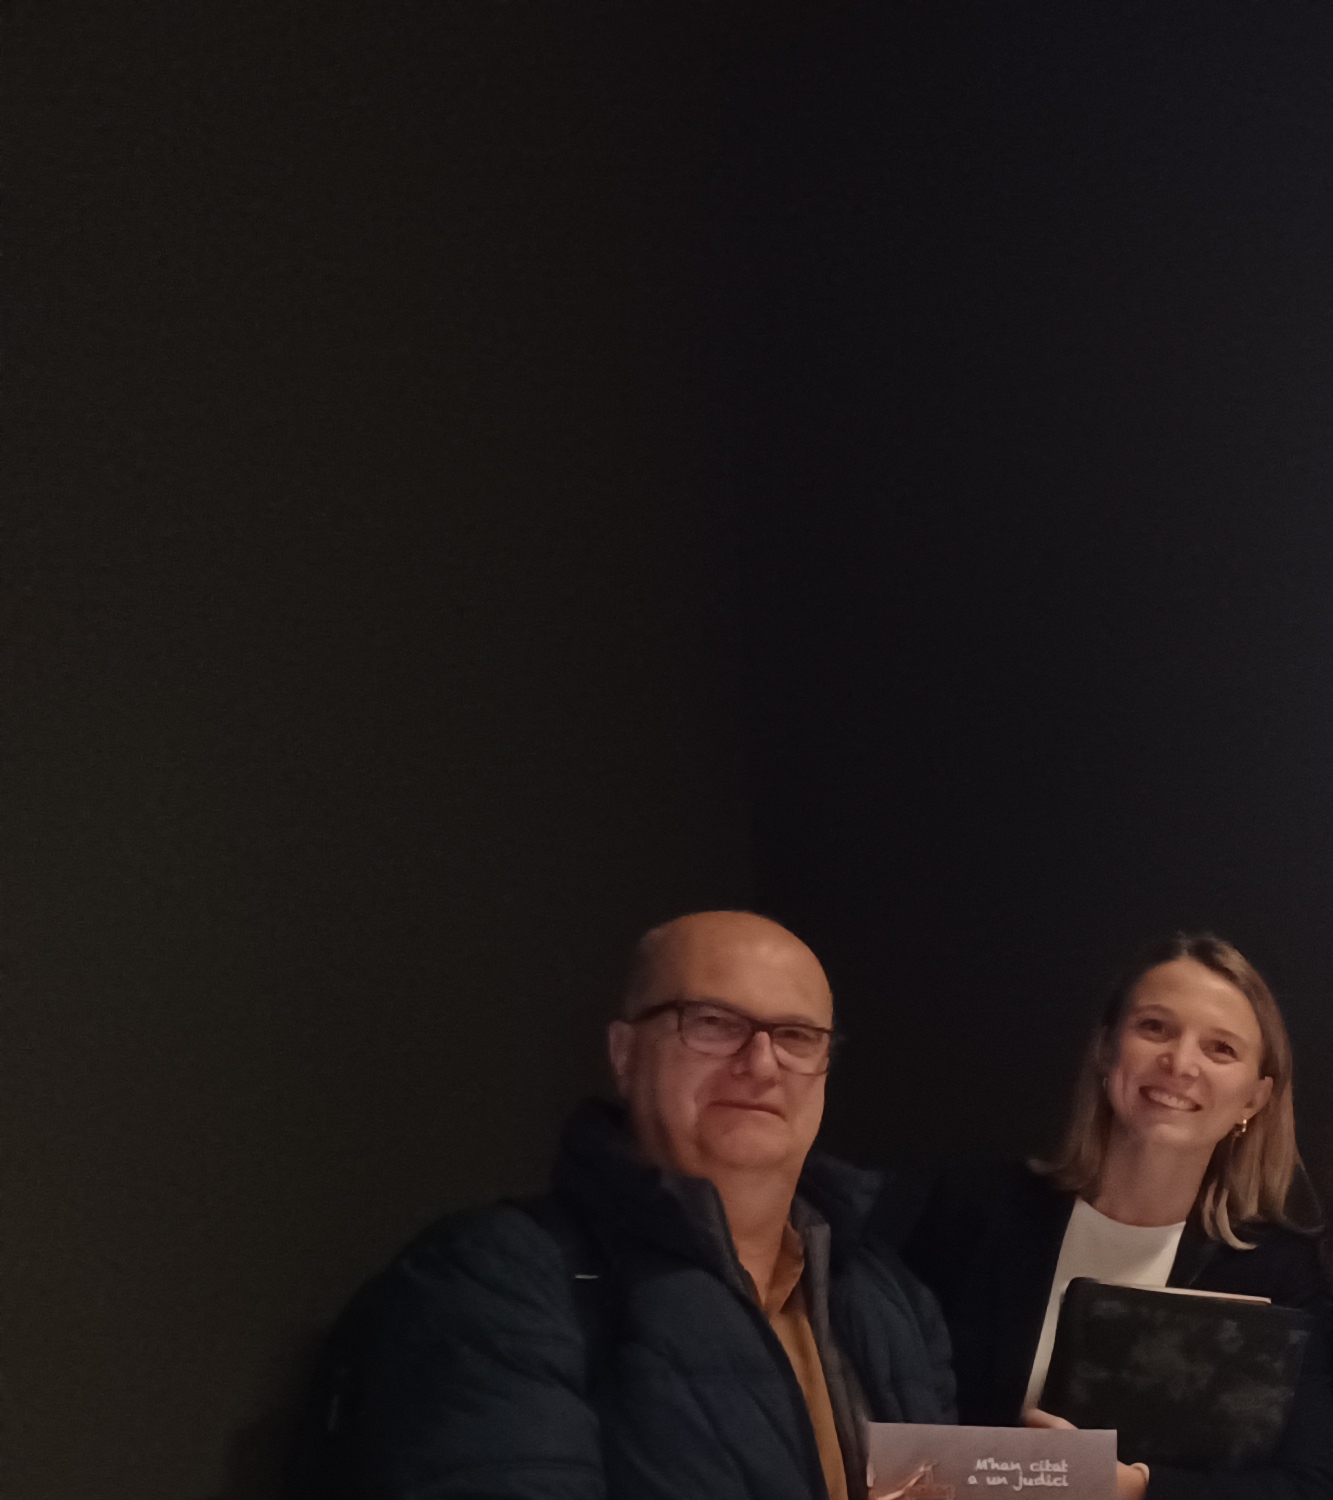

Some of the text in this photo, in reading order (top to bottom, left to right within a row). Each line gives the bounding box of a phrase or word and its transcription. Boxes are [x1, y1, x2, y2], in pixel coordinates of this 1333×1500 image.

[1030, 1459, 1068, 1472] citat
[968, 1475, 978, 1484] a
[986, 1476, 1008, 1485] un
